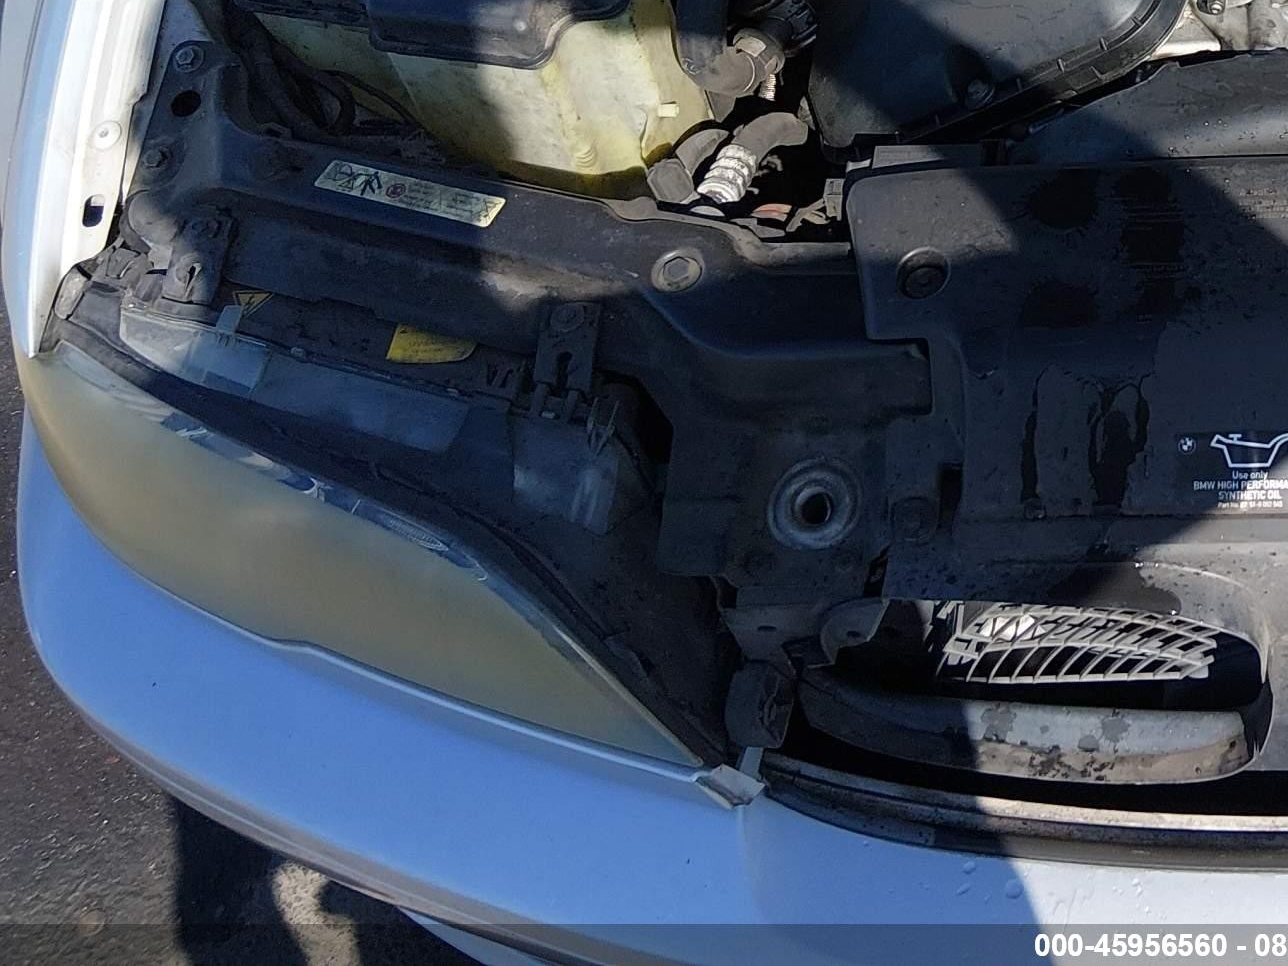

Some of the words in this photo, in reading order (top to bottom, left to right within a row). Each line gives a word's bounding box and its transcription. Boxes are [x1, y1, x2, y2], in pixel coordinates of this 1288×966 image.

[1232, 470, 1248, 480] Use
[1250, 470, 1268, 481] only
[1193, 480, 1216, 490] BMW
[1217, 480, 1239, 490] HIGH
[1218, 490, 1266, 500] SYNTHETIC
[1267, 490, 1282, 500] OIL
